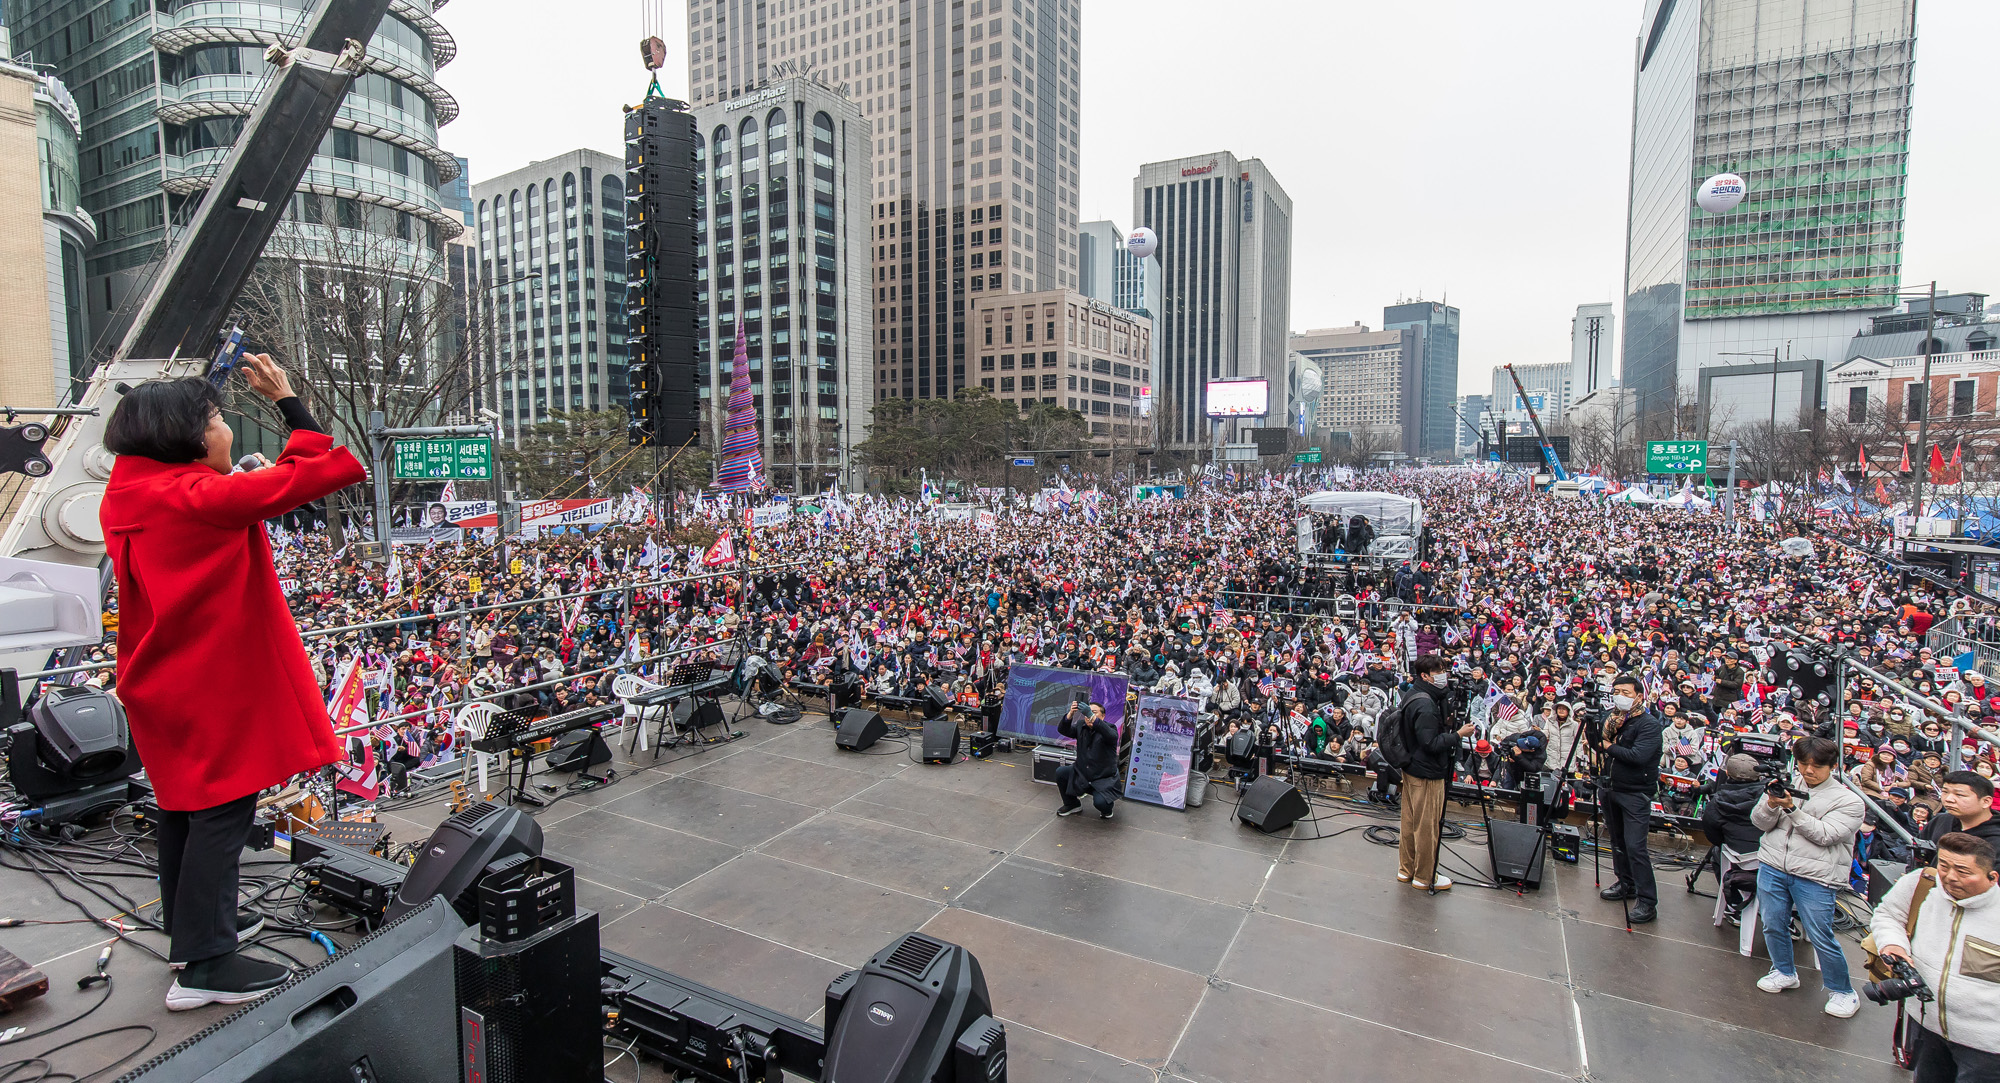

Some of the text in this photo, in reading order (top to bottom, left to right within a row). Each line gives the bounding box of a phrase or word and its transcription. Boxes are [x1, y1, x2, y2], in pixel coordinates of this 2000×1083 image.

[724, 86, 786, 112] Premier Place
[1181, 165, 1212, 177] kobaco
[1711, 186, 1741, 194] 국민대회
[427, 442, 452, 454] 종로1가
[459, 443, 487, 455] 서대문역
[1651, 443, 1701, 454] 종로1가
[449, 501, 487, 521] 윤석열
[561, 502, 608, 523] 지킵니다!
[522, 730, 539, 740] YAMAHA
